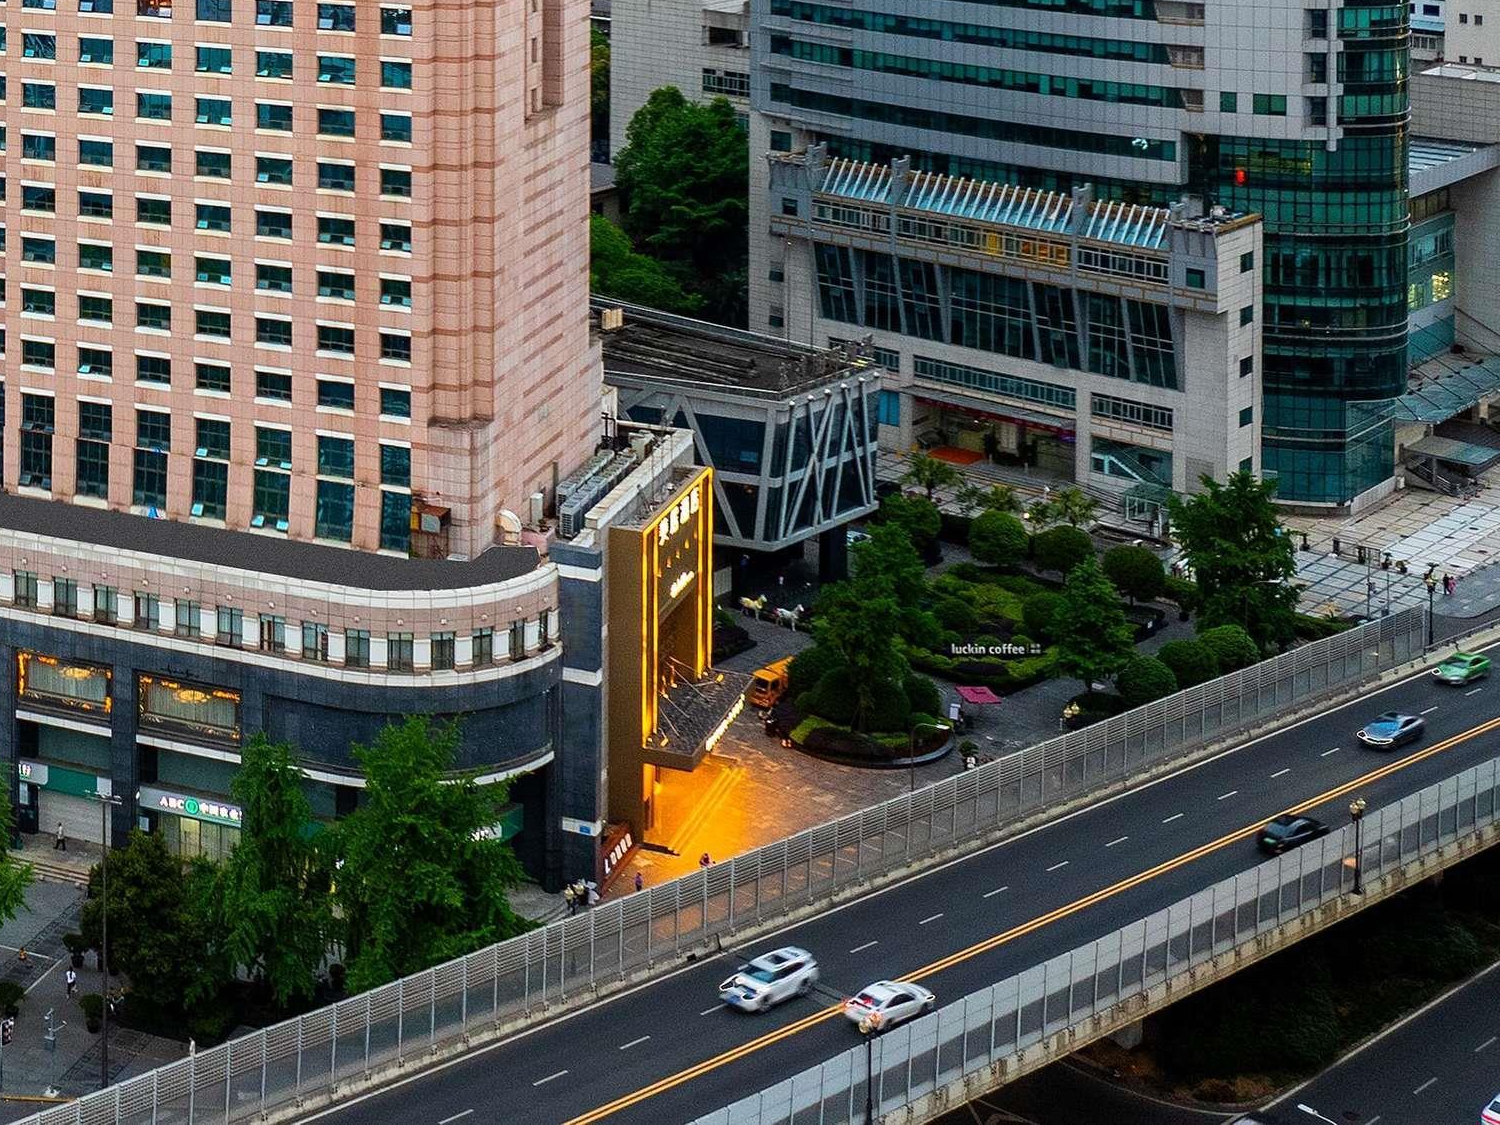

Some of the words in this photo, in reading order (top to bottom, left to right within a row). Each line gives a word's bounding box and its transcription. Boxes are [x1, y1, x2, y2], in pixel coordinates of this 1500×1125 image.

[951, 643, 986, 655] luckin
[989, 643, 1025, 655] coffee
[160, 796, 184, 809] ABC
